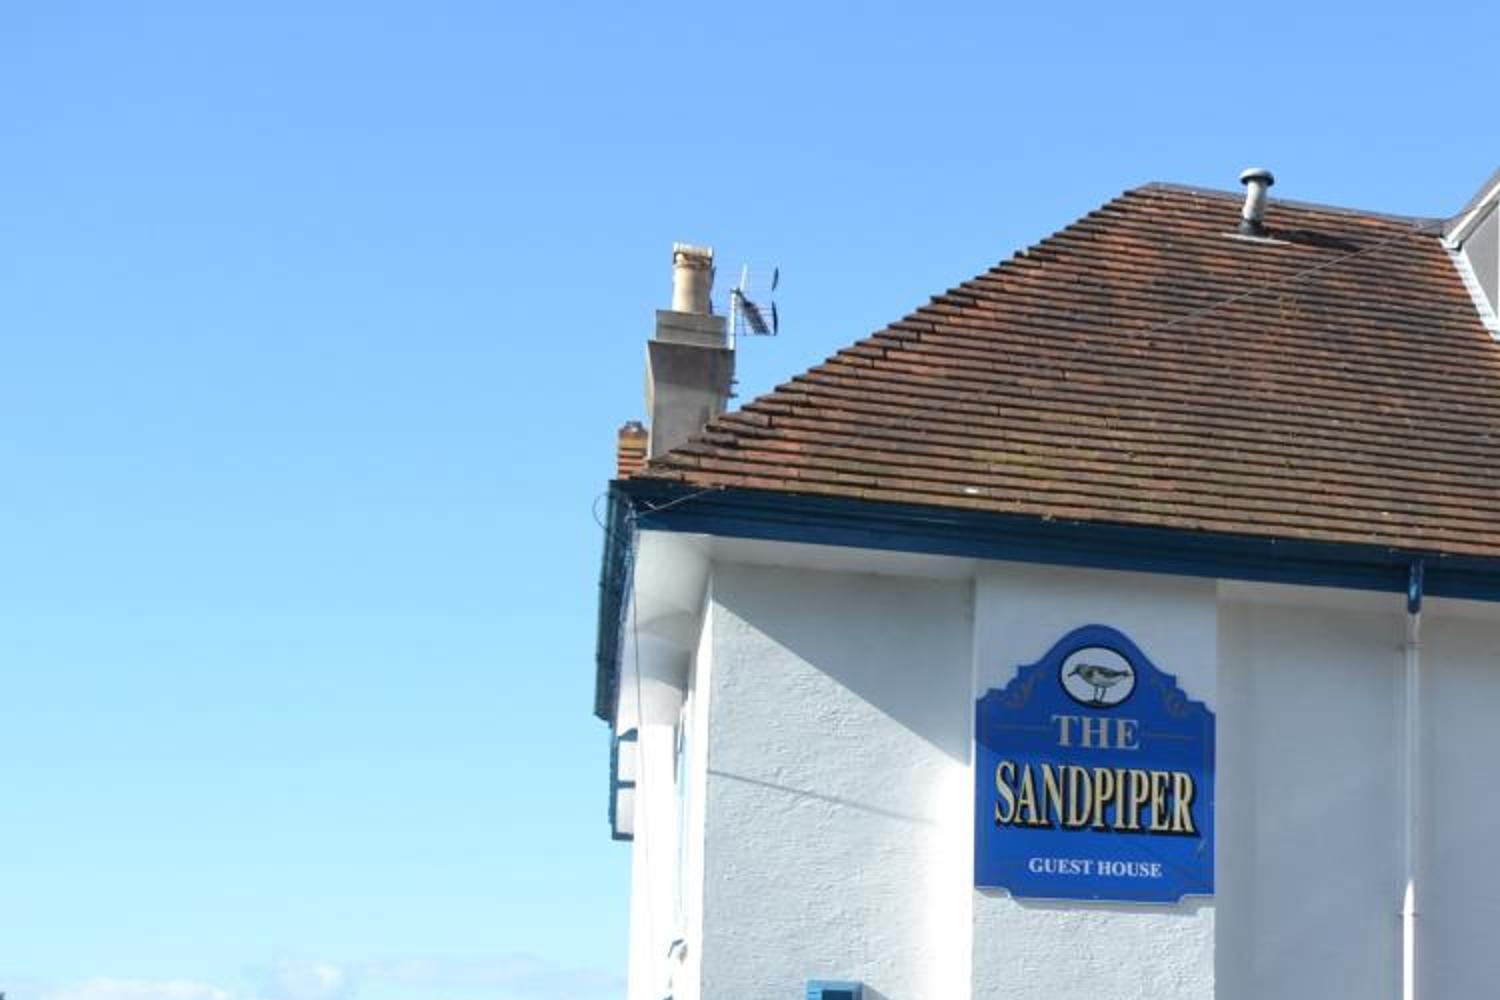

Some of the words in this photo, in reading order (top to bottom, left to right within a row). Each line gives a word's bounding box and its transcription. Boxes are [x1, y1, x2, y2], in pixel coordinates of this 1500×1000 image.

[1052, 713, 1140, 750] THE
[994, 760, 1198, 834] SANDPIPER
[1028, 857, 1092, 876] GUEST
[1097, 859, 1163, 878] HOUSE
